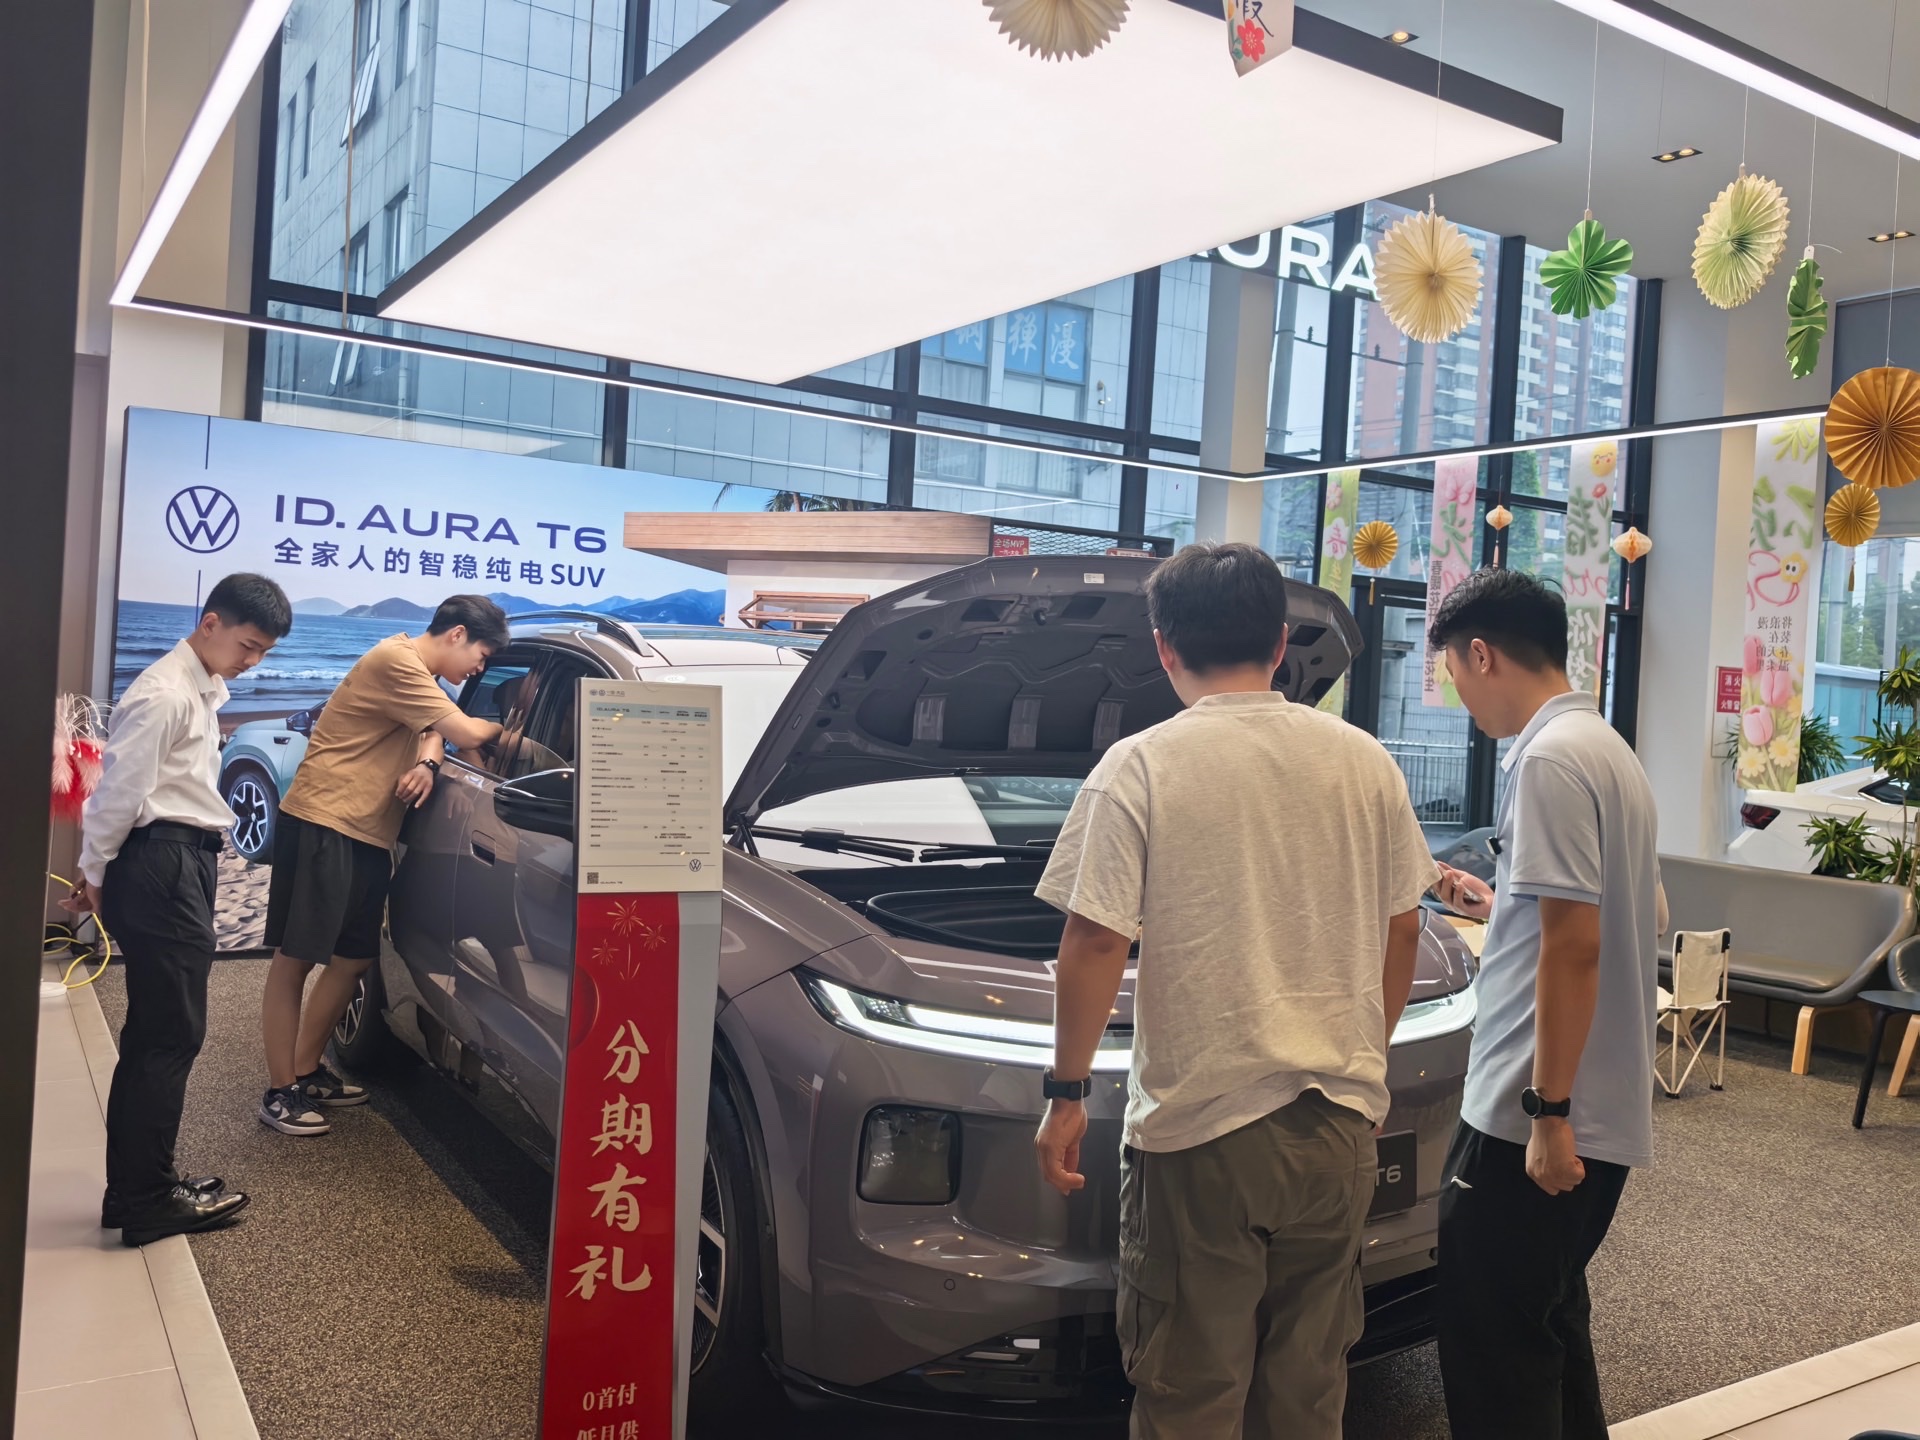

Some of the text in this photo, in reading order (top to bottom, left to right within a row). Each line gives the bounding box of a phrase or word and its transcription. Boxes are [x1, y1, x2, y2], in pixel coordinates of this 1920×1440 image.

[1194, 225, 1381, 302] URA
[274, 537, 606, 588] 全家人的智稳纯电SUV
[536, 521, 607, 554] T6
[566, 1018, 653, 1301] 分期有礼
[582, 1382, 638, 1412] 0首付
